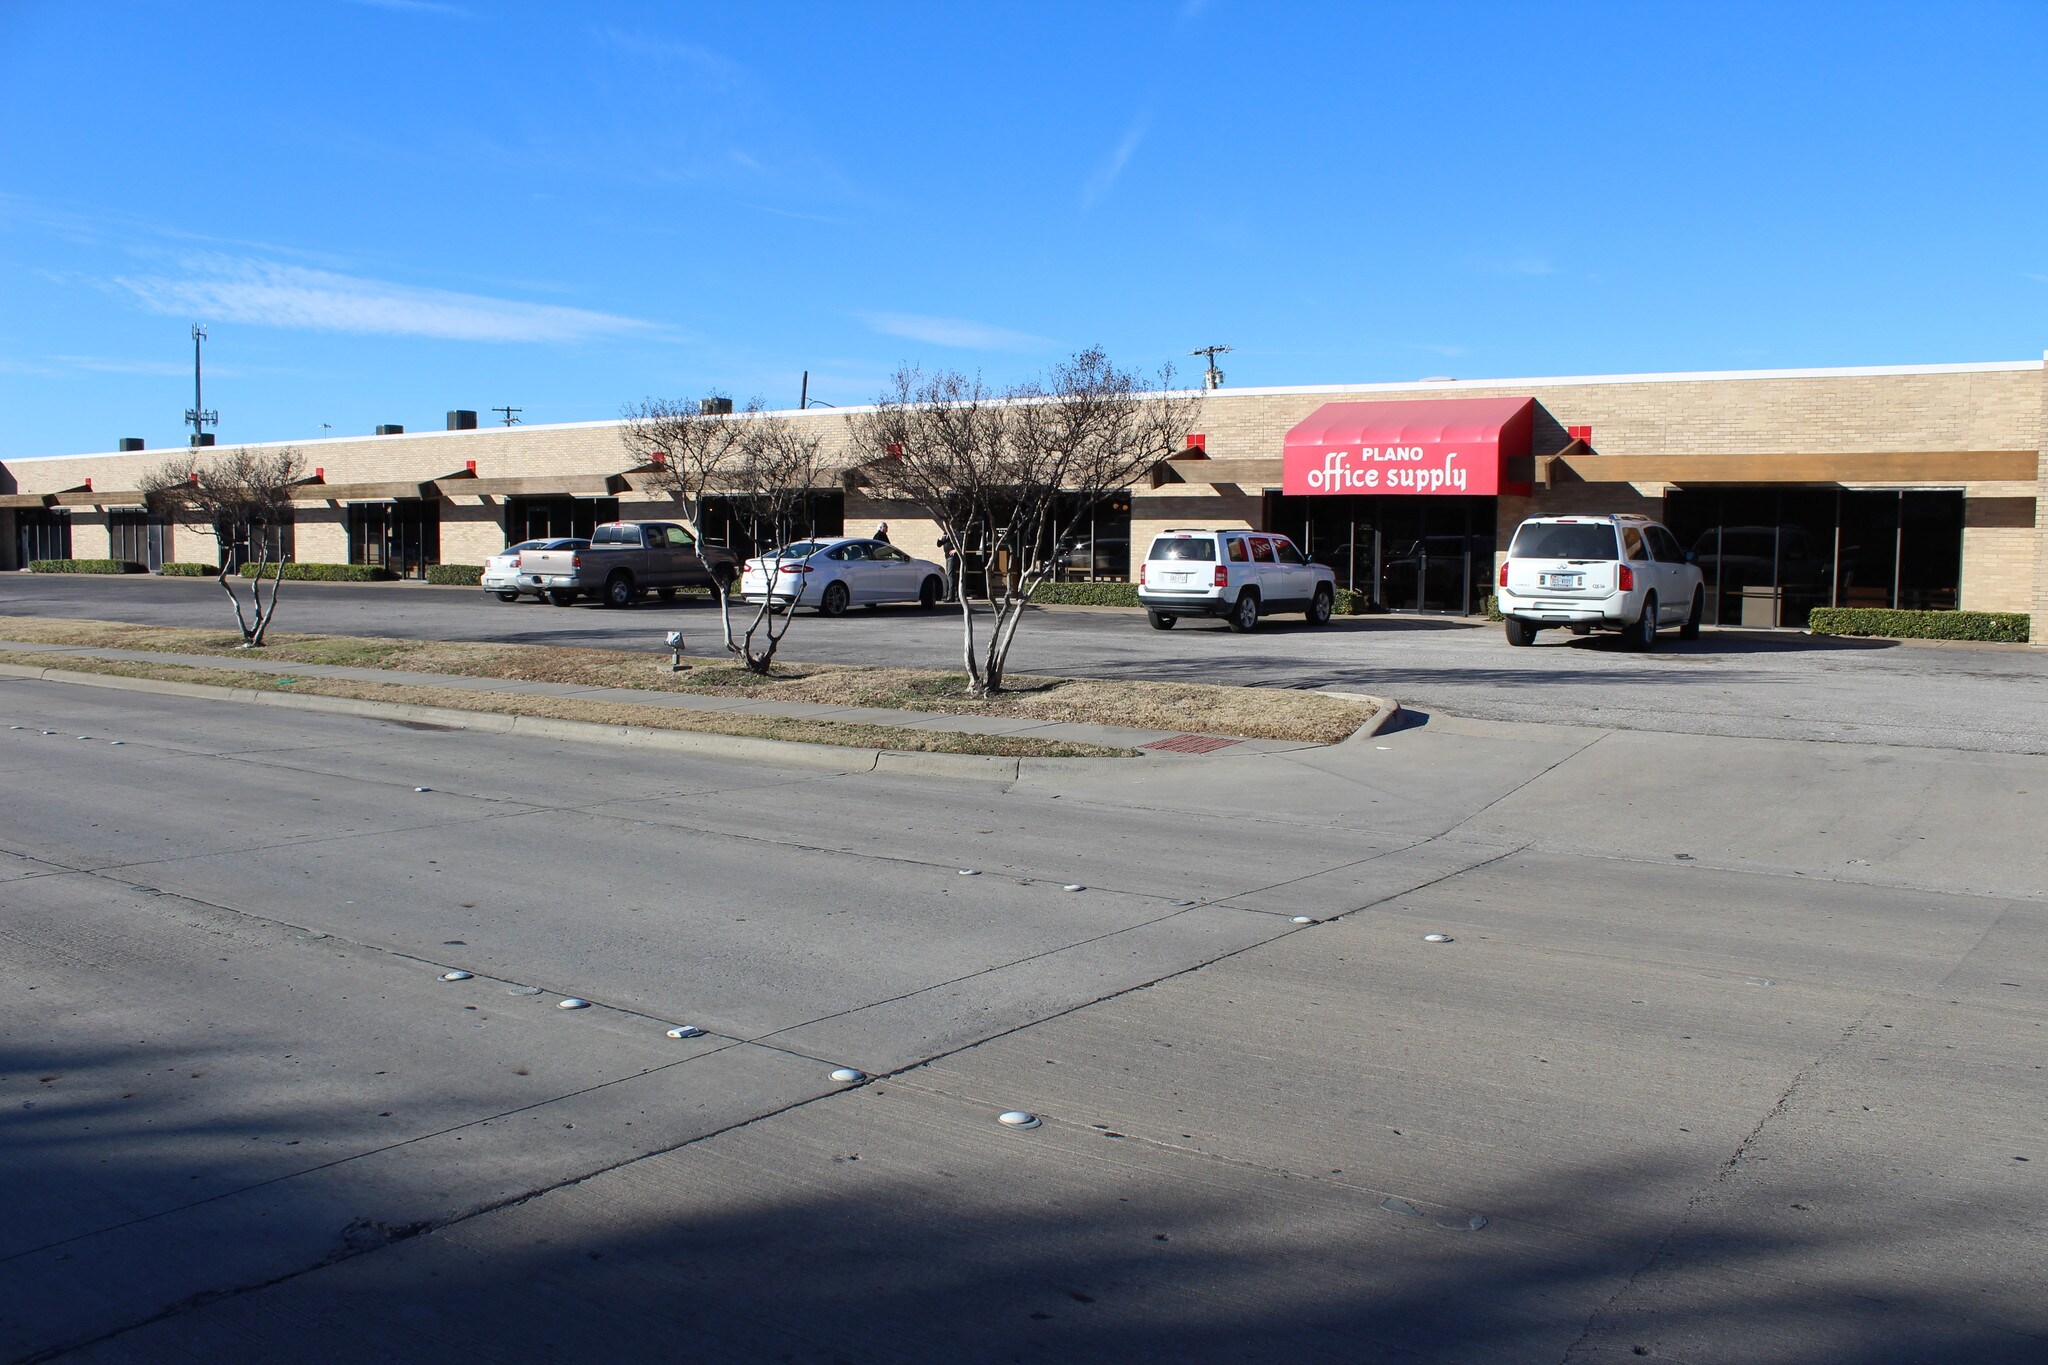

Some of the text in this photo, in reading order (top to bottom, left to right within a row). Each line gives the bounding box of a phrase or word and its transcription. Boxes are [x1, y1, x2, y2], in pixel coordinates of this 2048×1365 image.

[1362, 447, 1423, 461] PLANO
[1307, 452, 1467, 492] office supply
